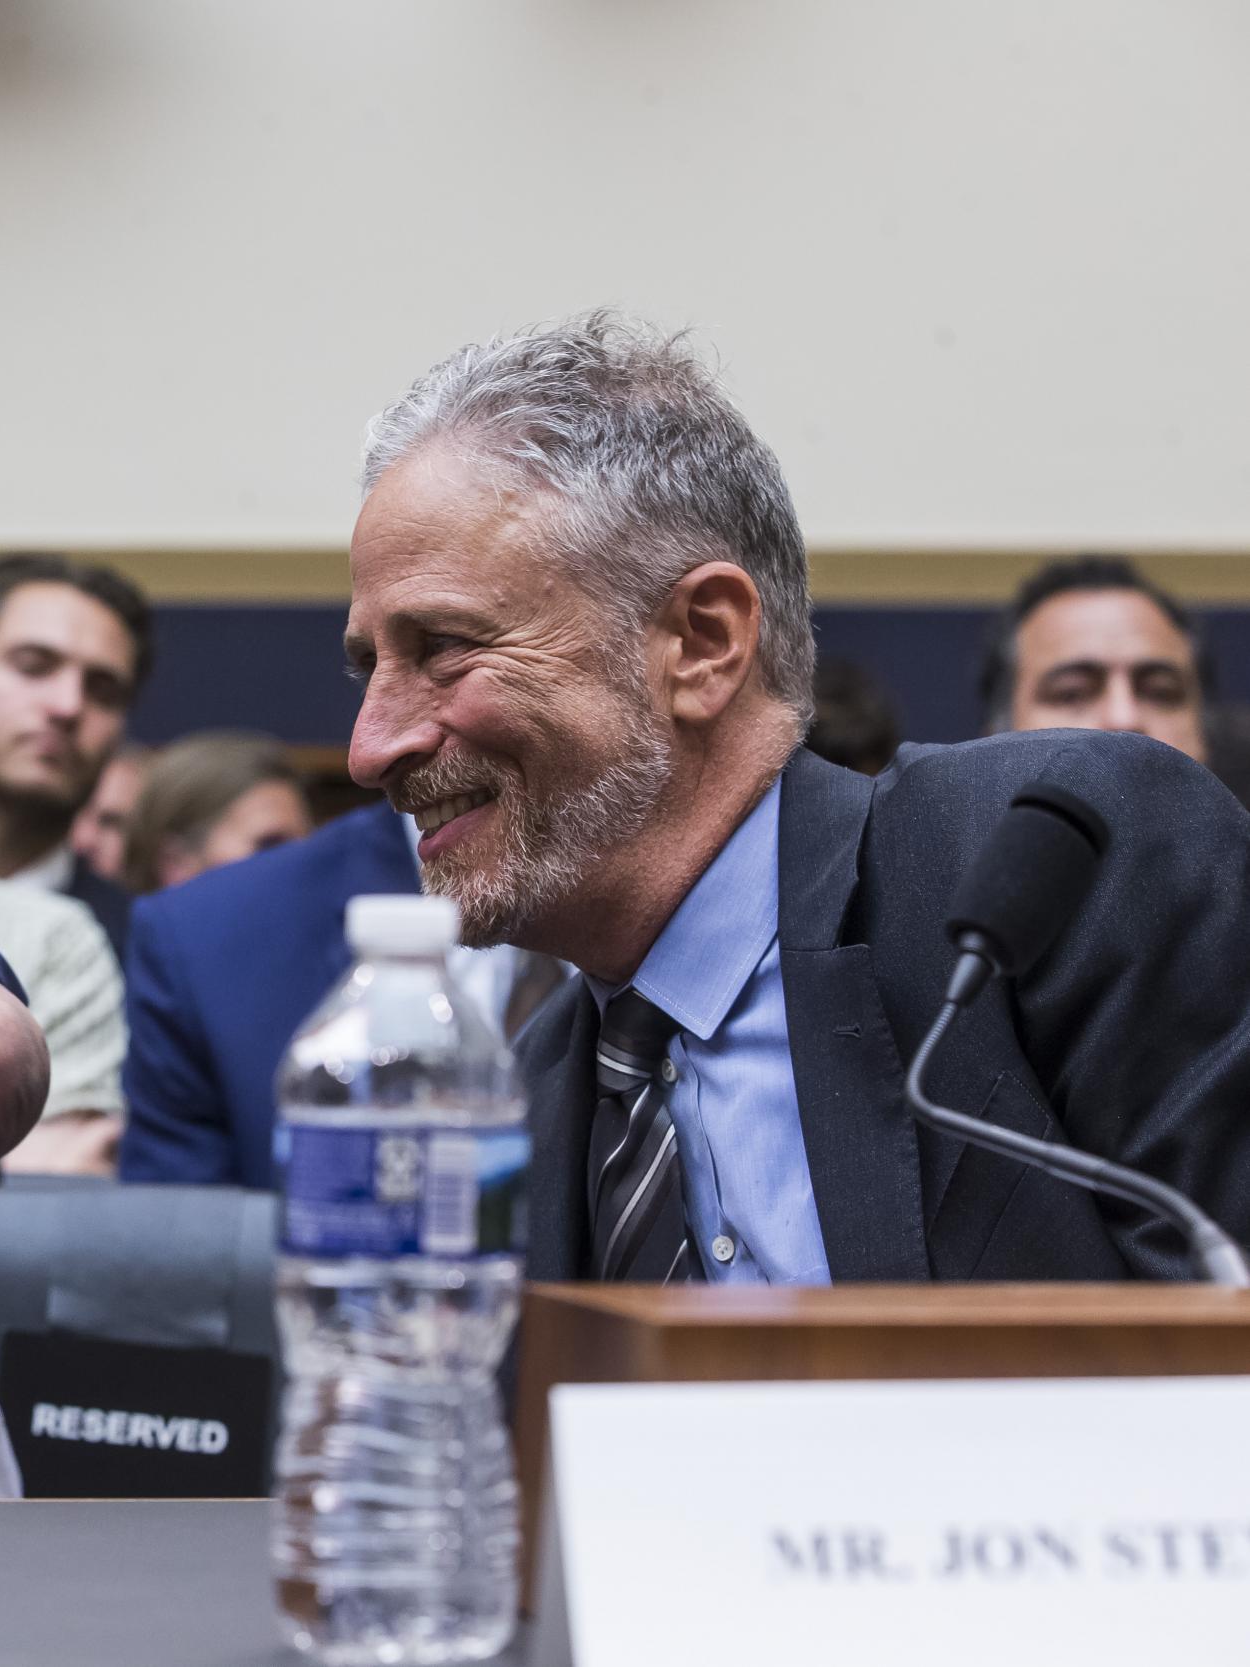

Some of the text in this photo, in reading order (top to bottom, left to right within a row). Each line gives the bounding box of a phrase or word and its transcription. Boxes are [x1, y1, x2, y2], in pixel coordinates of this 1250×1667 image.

[32, 1403, 228, 1454] RESERVED
[768, 1520, 1250, 1583] MR. JON STE
